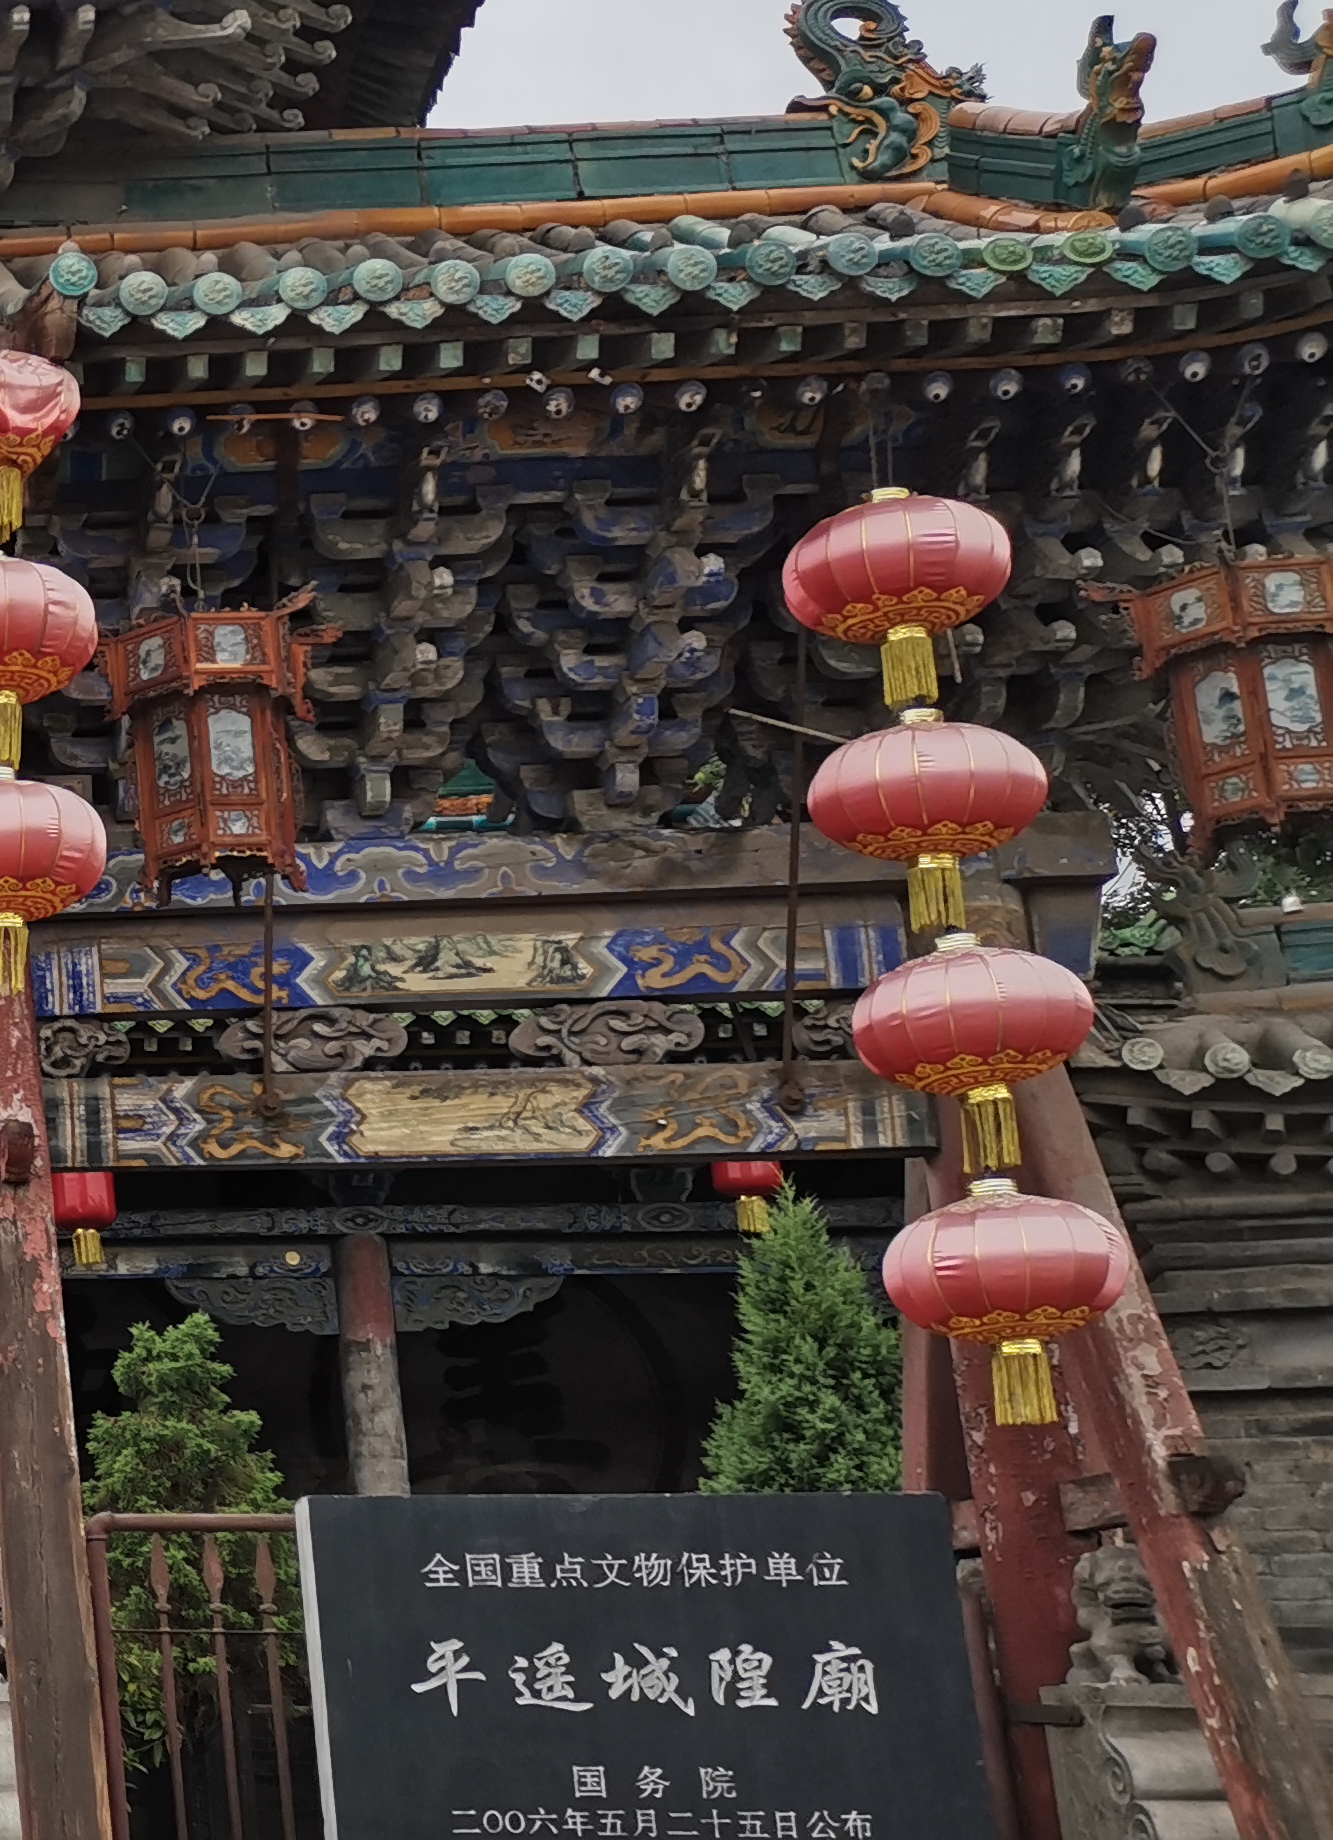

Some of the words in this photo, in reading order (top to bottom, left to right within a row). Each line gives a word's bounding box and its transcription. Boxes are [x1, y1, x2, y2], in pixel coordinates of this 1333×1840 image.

[420, 1550, 850, 1588] 全国重点文物保护单位
[572, 1764, 737, 1799] 国务院
